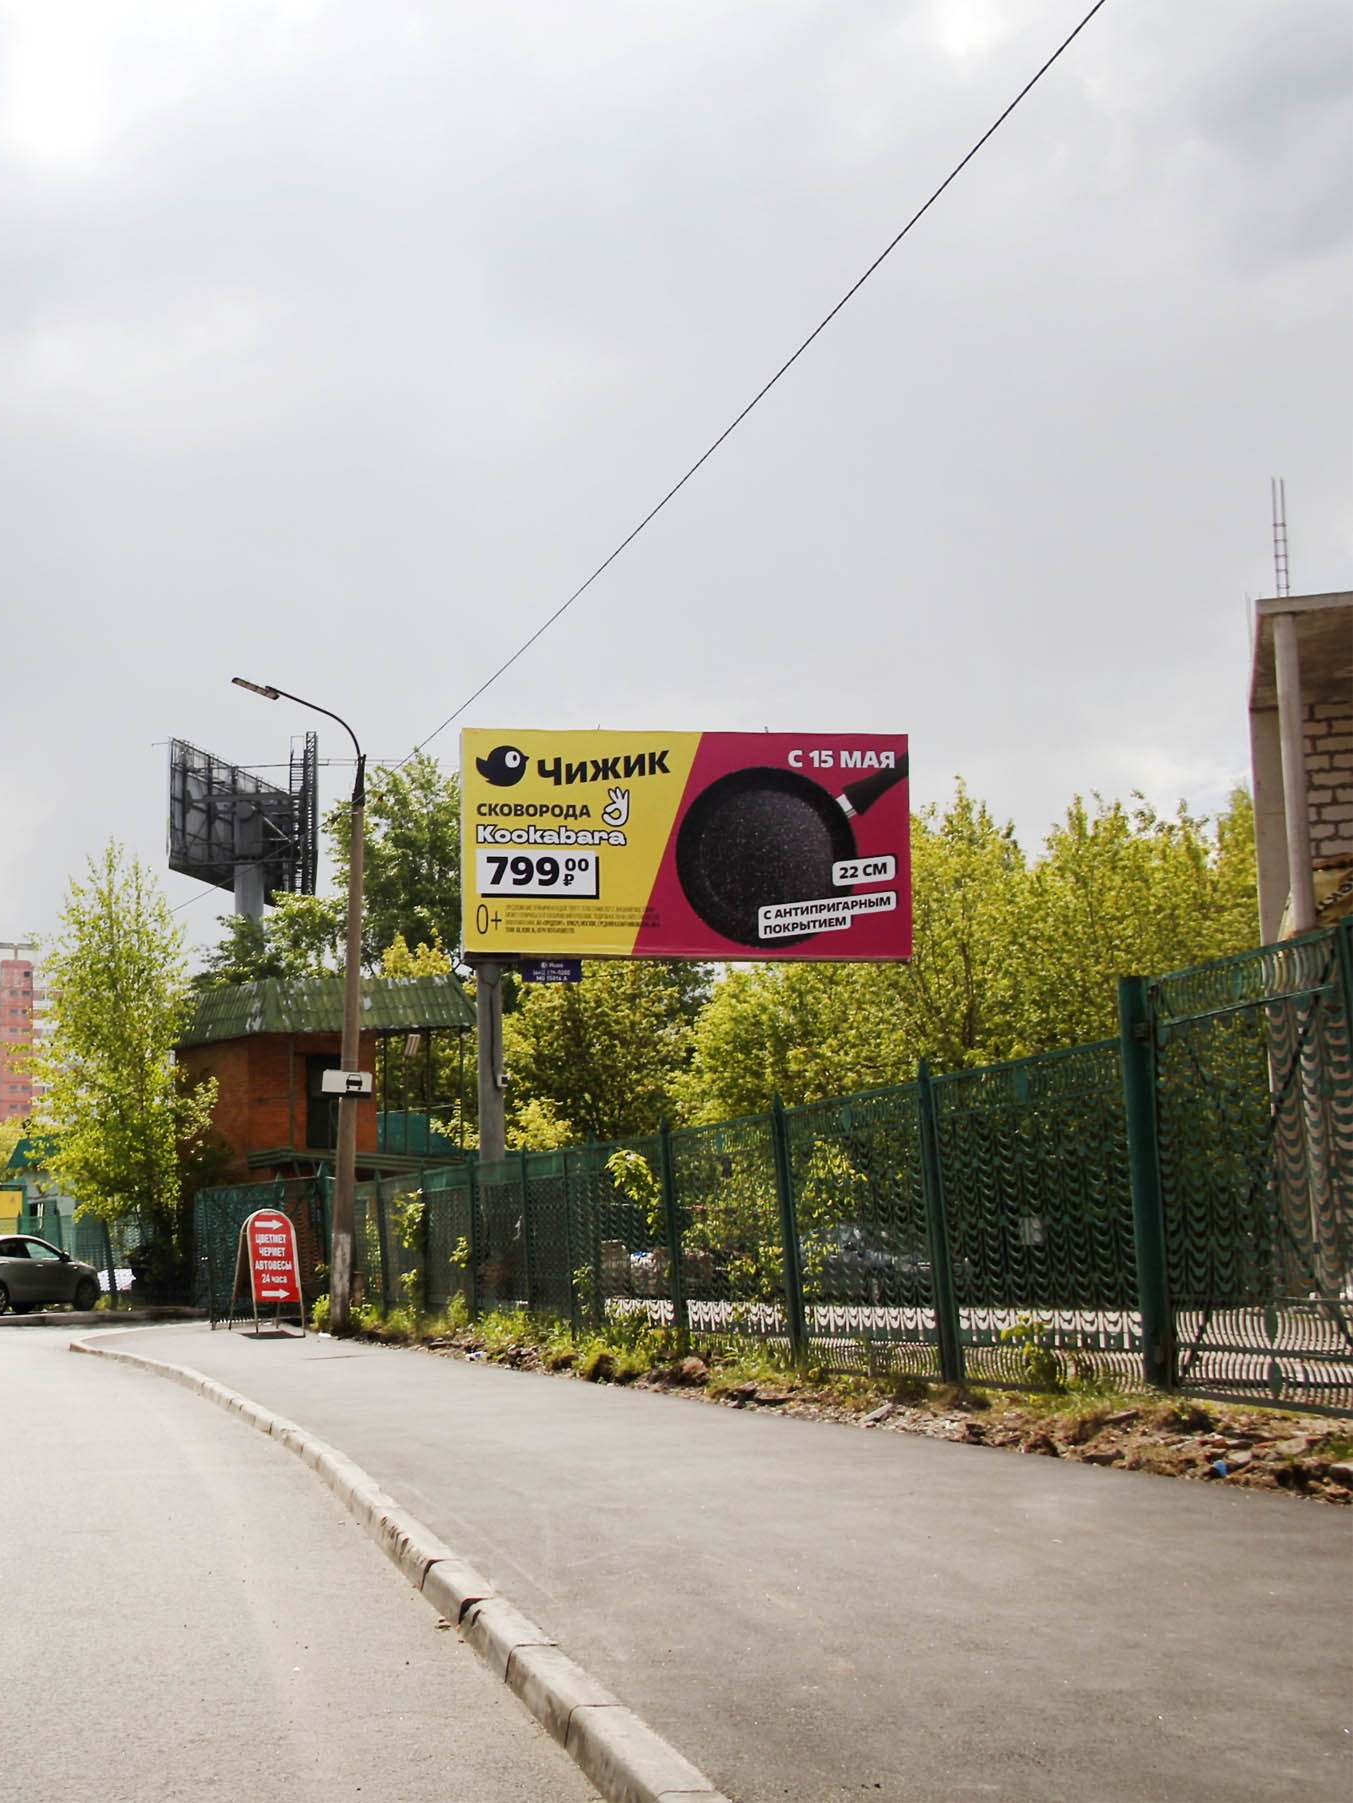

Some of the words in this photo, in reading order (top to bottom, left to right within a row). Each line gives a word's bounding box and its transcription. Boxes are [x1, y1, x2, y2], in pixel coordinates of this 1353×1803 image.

[788, 750, 803, 768] С
[809, 750, 834, 768] 15
[840, 750, 895, 768] МАЯ
[537, 750, 671, 786] Чижик
[477, 803, 591, 820] СКОВОРОДА
[476, 824, 627, 846] Kookabara
[839, 866, 858, 879] 22
[862, 862, 887, 877] СМ
[763, 910, 772, 920] С
[774, 896, 891, 920] АНТИПРИГАРНЫМ
[476, 904, 502, 934] 0+
[764, 916, 847, 935] ПОКРЫТИЕМ
[255, 1233, 287, 1245] ЦВЕТМЕТ
[259, 1247, 286, 1257] ЧЕРМЕТ
[255, 1260, 292, 1270] АВТОВЕСЫ
[260, 1273, 270, 1283] 24
